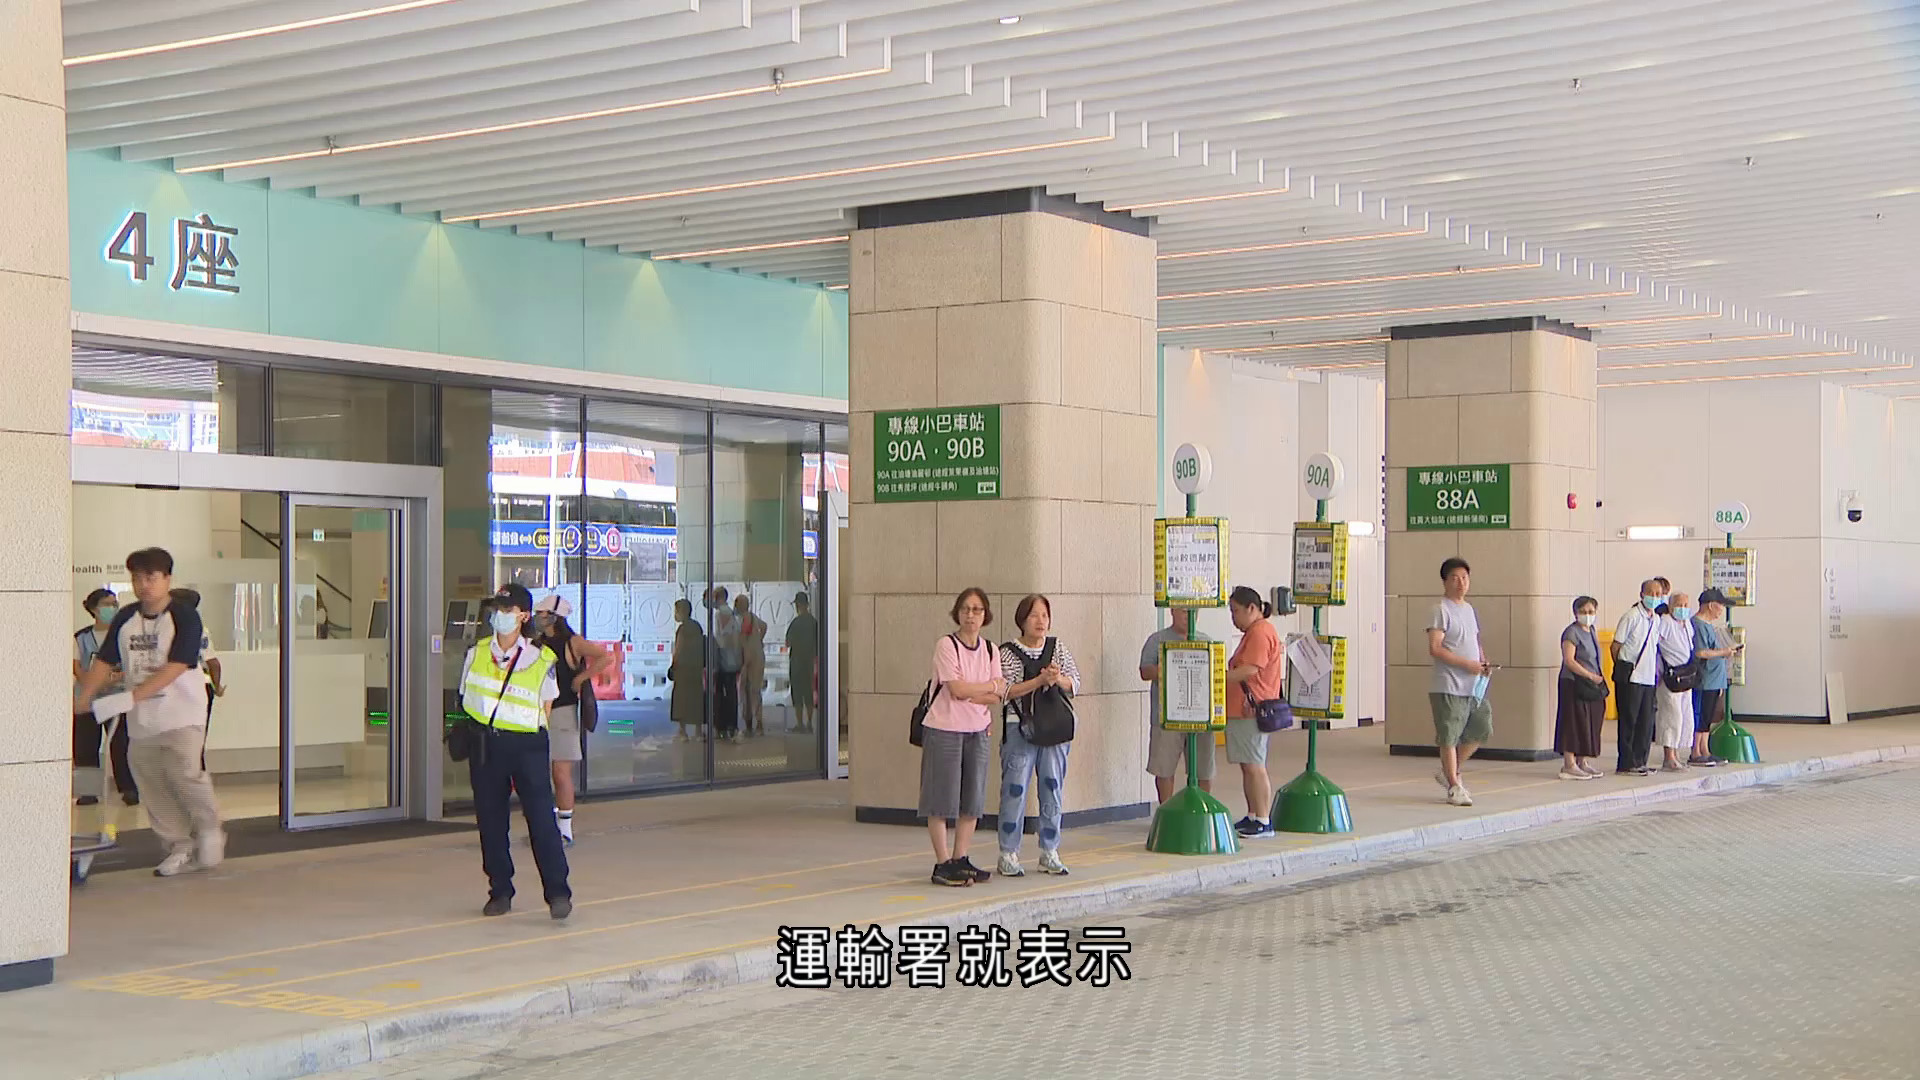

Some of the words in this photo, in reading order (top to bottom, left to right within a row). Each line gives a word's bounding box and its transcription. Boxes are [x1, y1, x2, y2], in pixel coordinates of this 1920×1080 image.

[888, 412, 985, 435] 專線小巴車站
[888, 440, 926, 462] 90A
[947, 437, 985, 460] 90B
[1175, 457, 1197, 480] 90B
[1307, 464, 1330, 488] 90A
[1418, 469, 1497, 485] 專線小巴車站
[1437, 489, 1480, 510] 88A
[1716, 510, 1744, 523] 88A
